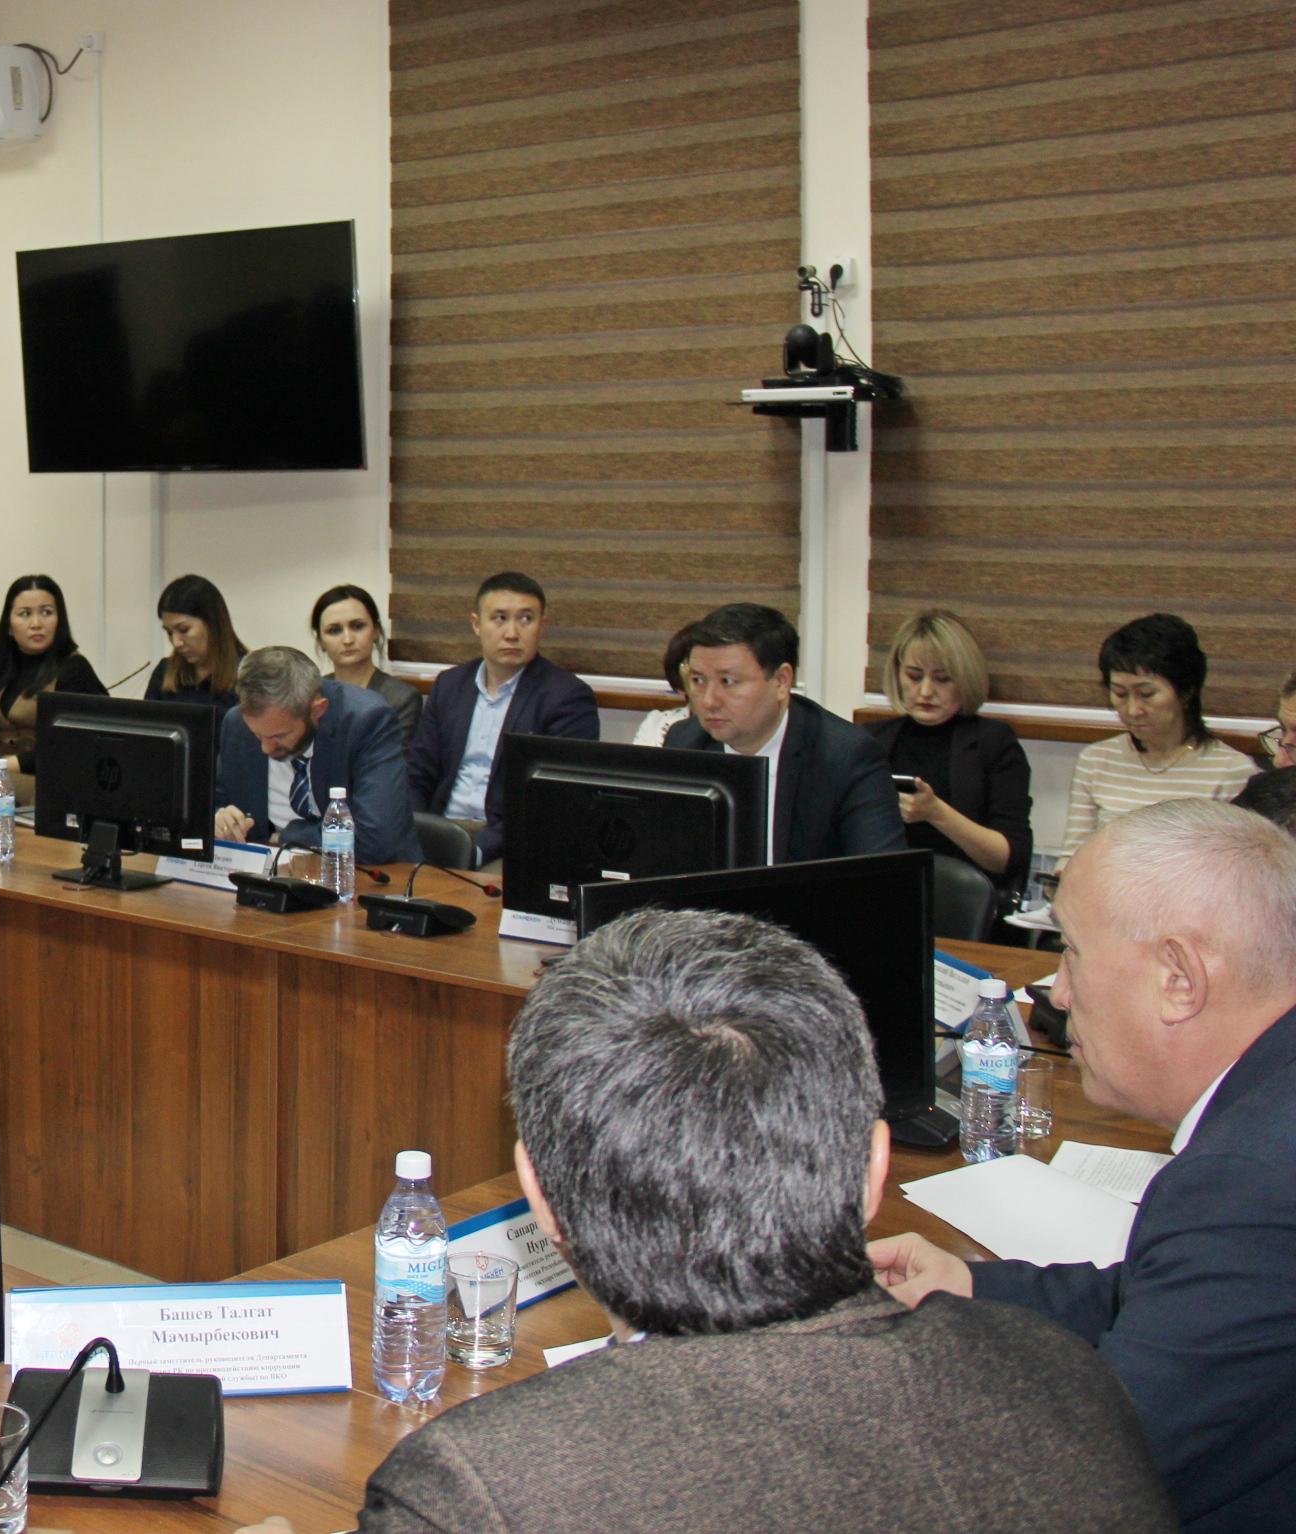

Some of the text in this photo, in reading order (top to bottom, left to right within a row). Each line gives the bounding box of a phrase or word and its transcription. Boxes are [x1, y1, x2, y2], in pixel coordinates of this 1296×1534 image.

[159, 1305, 273, 1321] Башев Талгат
[152, 1328, 279, 1345] Мамырбекович
[256, 1353, 307, 1361] Департамента
[261, 1363, 301, 1372] коррупции
[270, 1372, 288, 1380] ВКО
